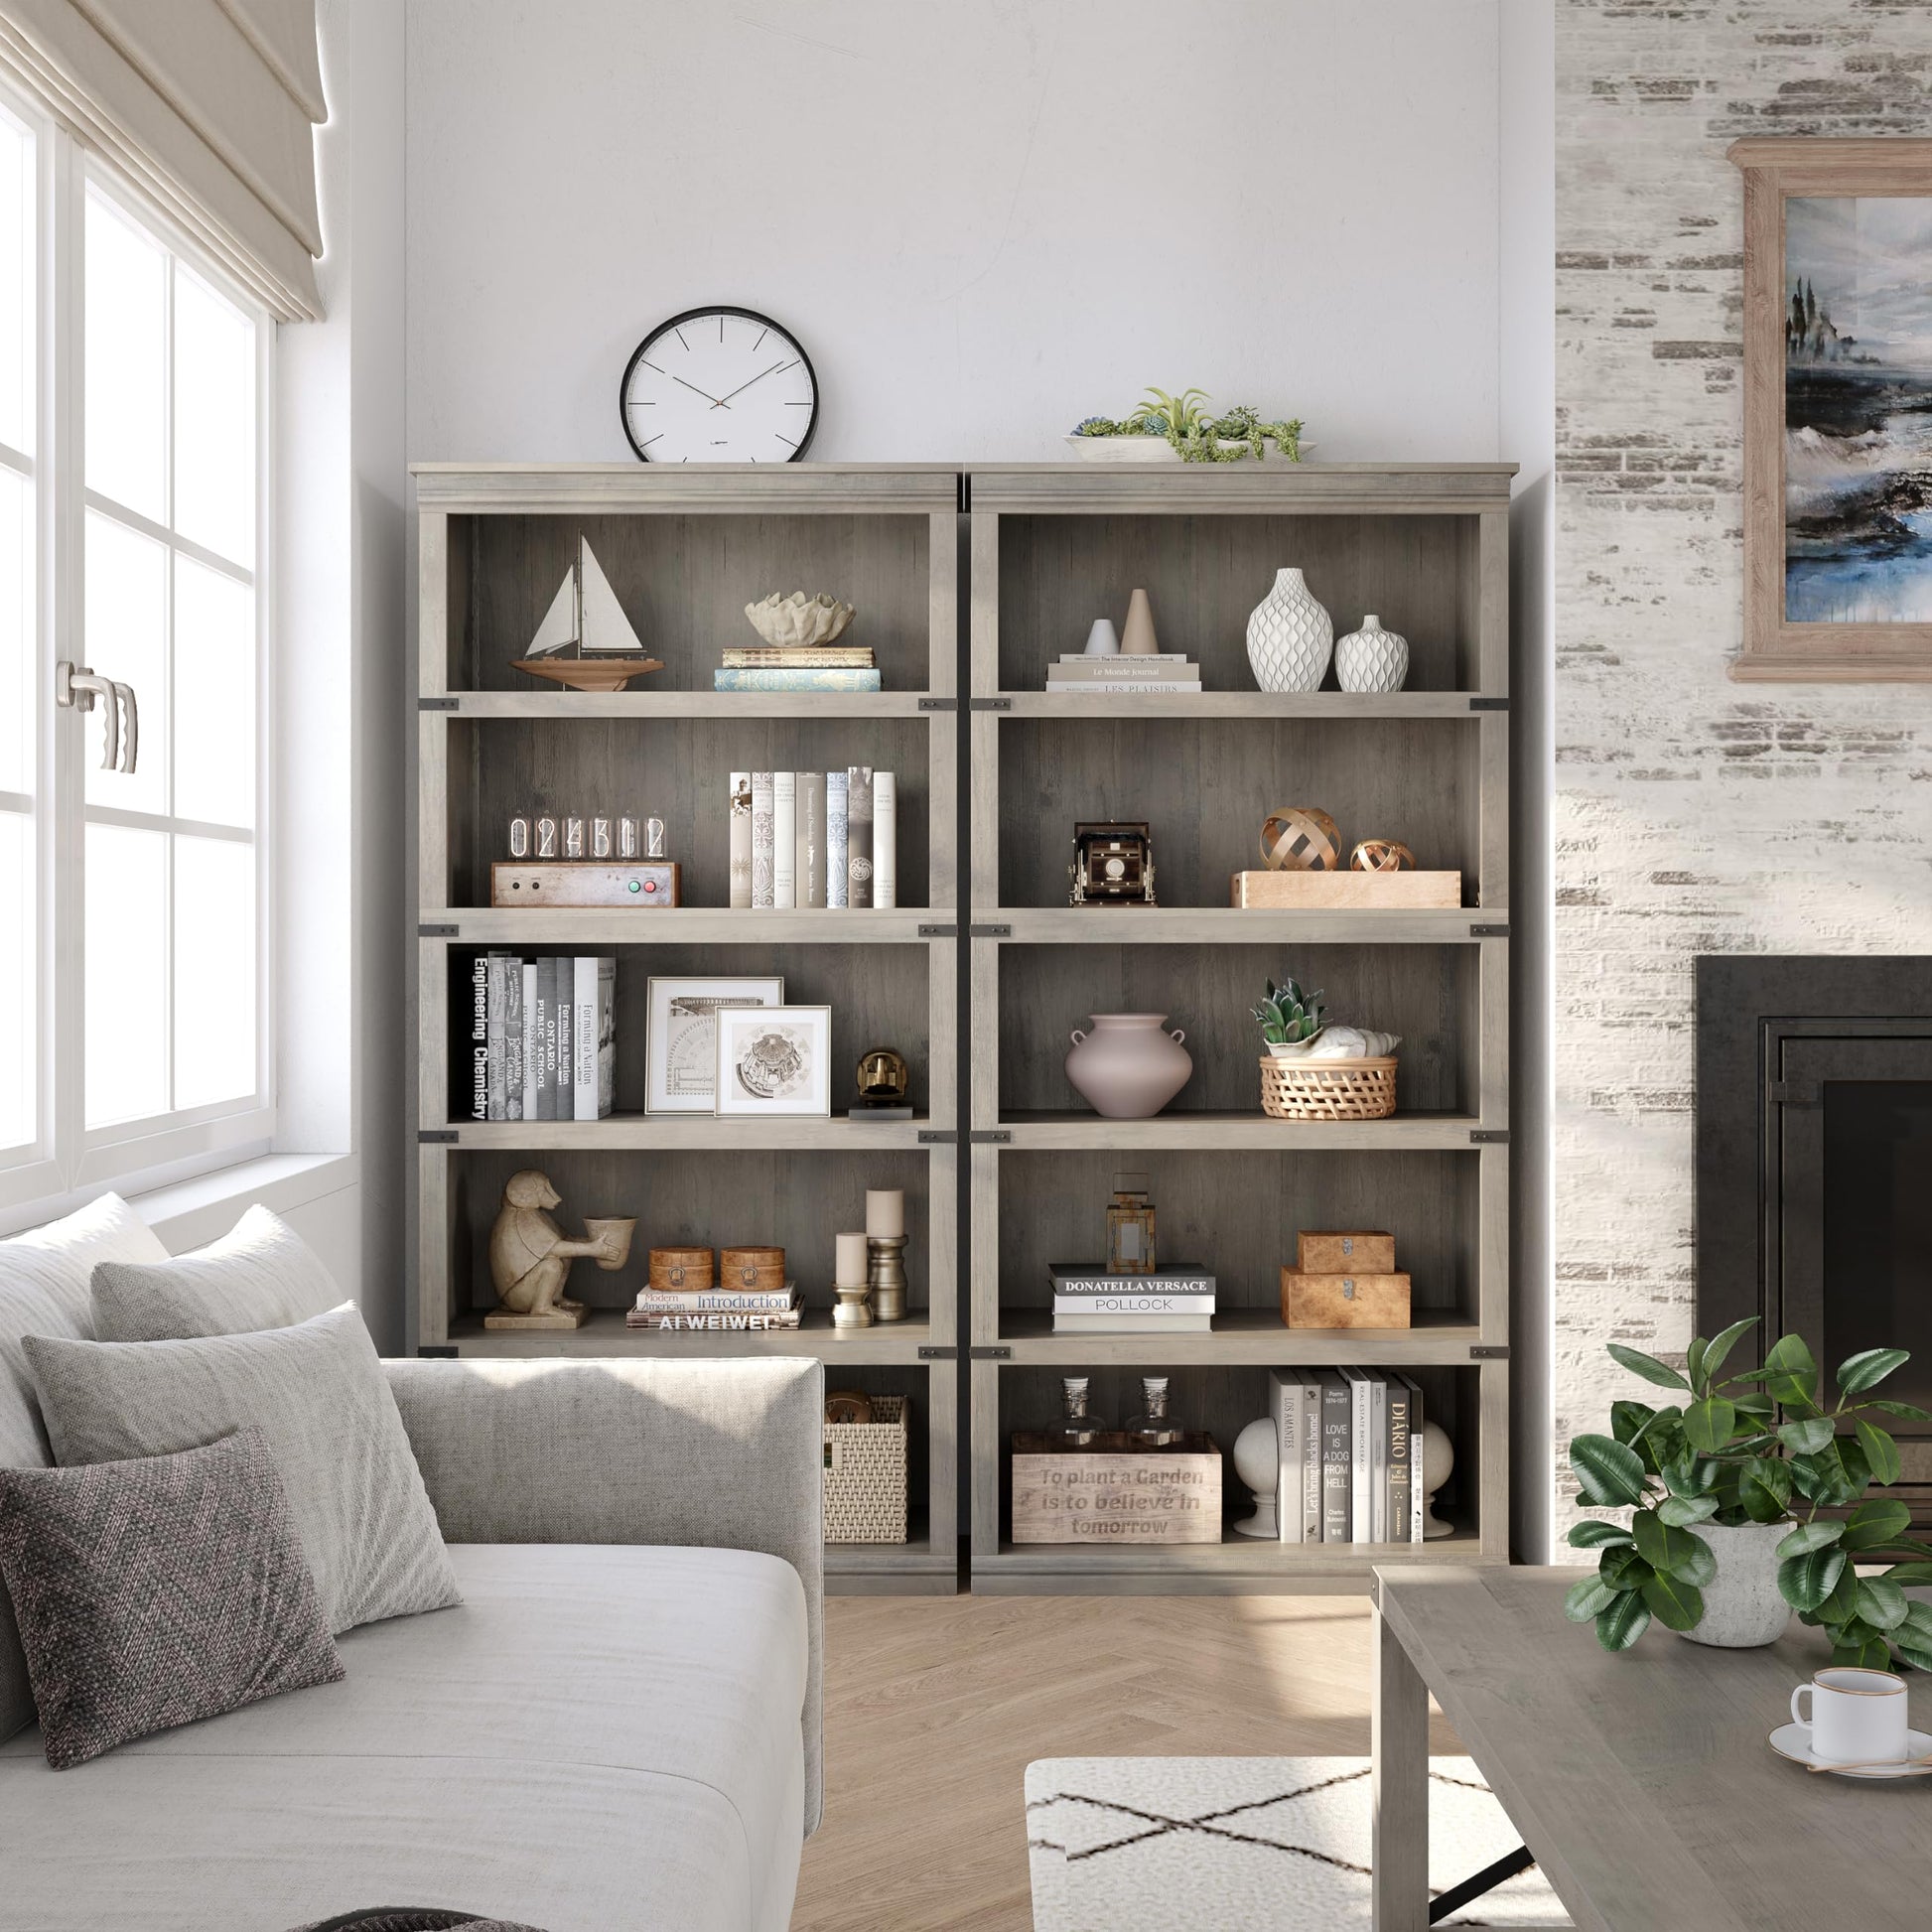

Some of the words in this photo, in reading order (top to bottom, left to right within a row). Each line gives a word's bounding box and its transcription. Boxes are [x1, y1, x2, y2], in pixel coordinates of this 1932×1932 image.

[1131, 668, 1160, 677] Journal
[473, 958, 488, 1039] Engineering
[562, 1004, 571, 1044] Forming
[583, 1004, 594, 1044] Forming
[505, 1035, 521, 1078] ENGLAND
[562, 1053, 571, 1085] Nation
[583, 1053, 594, 1085] Nation
[473, 1047, 488, 1120] Chemistry
[1065, 1281, 1144, 1292] DONATELLA
[1147, 1281, 1207, 1292] VERSACE
[641, 1302, 686, 1311] American
[644, 1294, 679, 1303] Modern
[697, 1295, 788, 1309] Introduction
[1095, 1299, 1173, 1311] POLLOCK
[659, 1315, 680, 1330] AI
[685, 1315, 770, 1330] WEIWEI
[1284, 1397, 1295, 1412] LOS
[1284, 1413, 1295, 1449] AMANTES
[1325, 1425, 1347, 1435] LOVE
[1391, 1403, 1409, 1458] DIÁRIO
[1332, 1438, 1341, 1448] IS
[1307, 1442, 1318, 1468] blacks
[1323, 1451, 1330, 1461] A
[1331, 1451, 1349, 1461] DOG
[1324, 1464, 1348, 1474] FROM
[1039, 1468, 1062, 1484] To
[1066, 1468, 1117, 1488] plant
[1120, 1472, 1132, 1485] a
[1136, 1468, 1204, 1485] Garden
[1307, 1468, 1320, 1492] bring
[1326, 1478, 1347, 1488] HELL
[1042, 1493, 1059, 1510] is
[1066, 1493, 1088, 1510] to
[1095, 1492, 1173, 1510] believe
[1179, 1492, 1200, 1510] in
[1307, 1493, 1318, 1514] Let's
[1071, 1518, 1169, 1534] tomorrow
